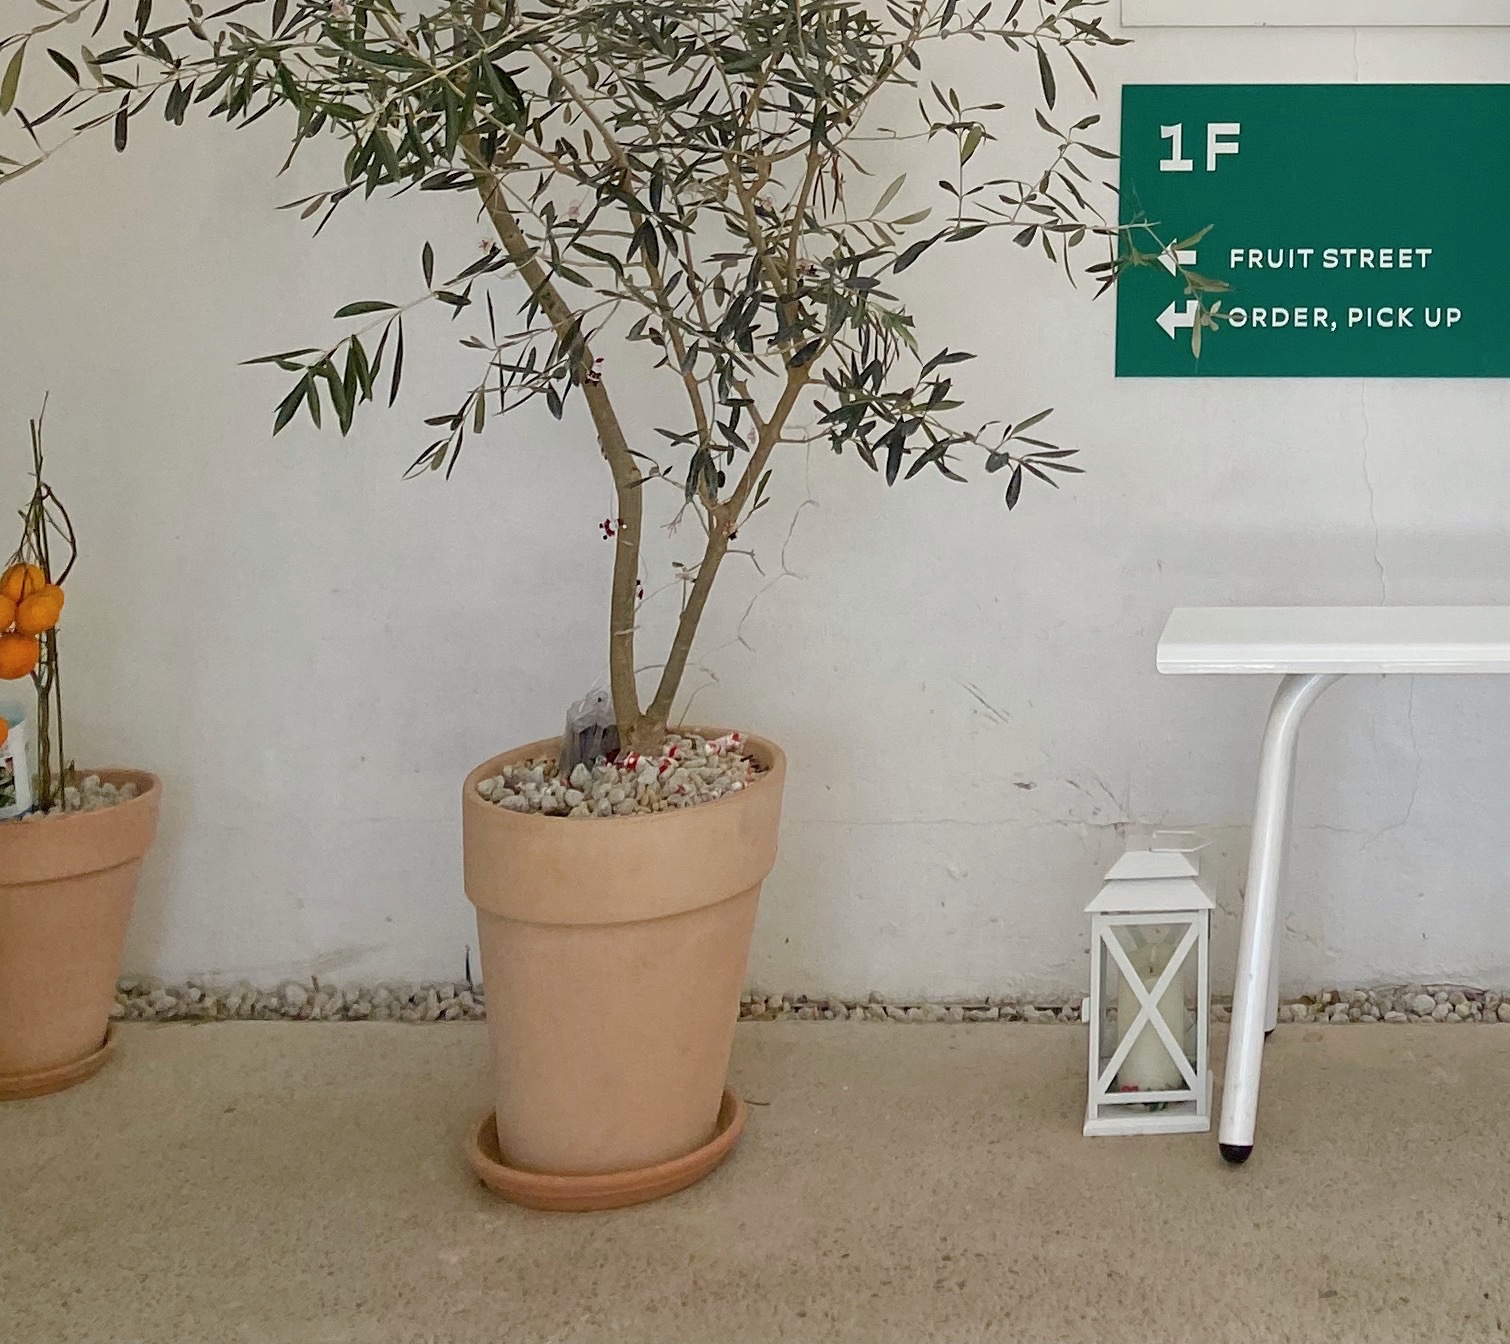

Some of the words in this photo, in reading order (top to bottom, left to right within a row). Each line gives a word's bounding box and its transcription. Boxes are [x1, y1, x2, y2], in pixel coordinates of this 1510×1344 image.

[1158, 122, 1242, 173] 1F
[1229, 248, 1315, 269] FRUIT
[1322, 248, 1433, 269] STREET
[1228, 307, 1338, 332] ORDER,
[1347, 307, 1414, 328] PICK
[1424, 307, 1463, 328] UP
